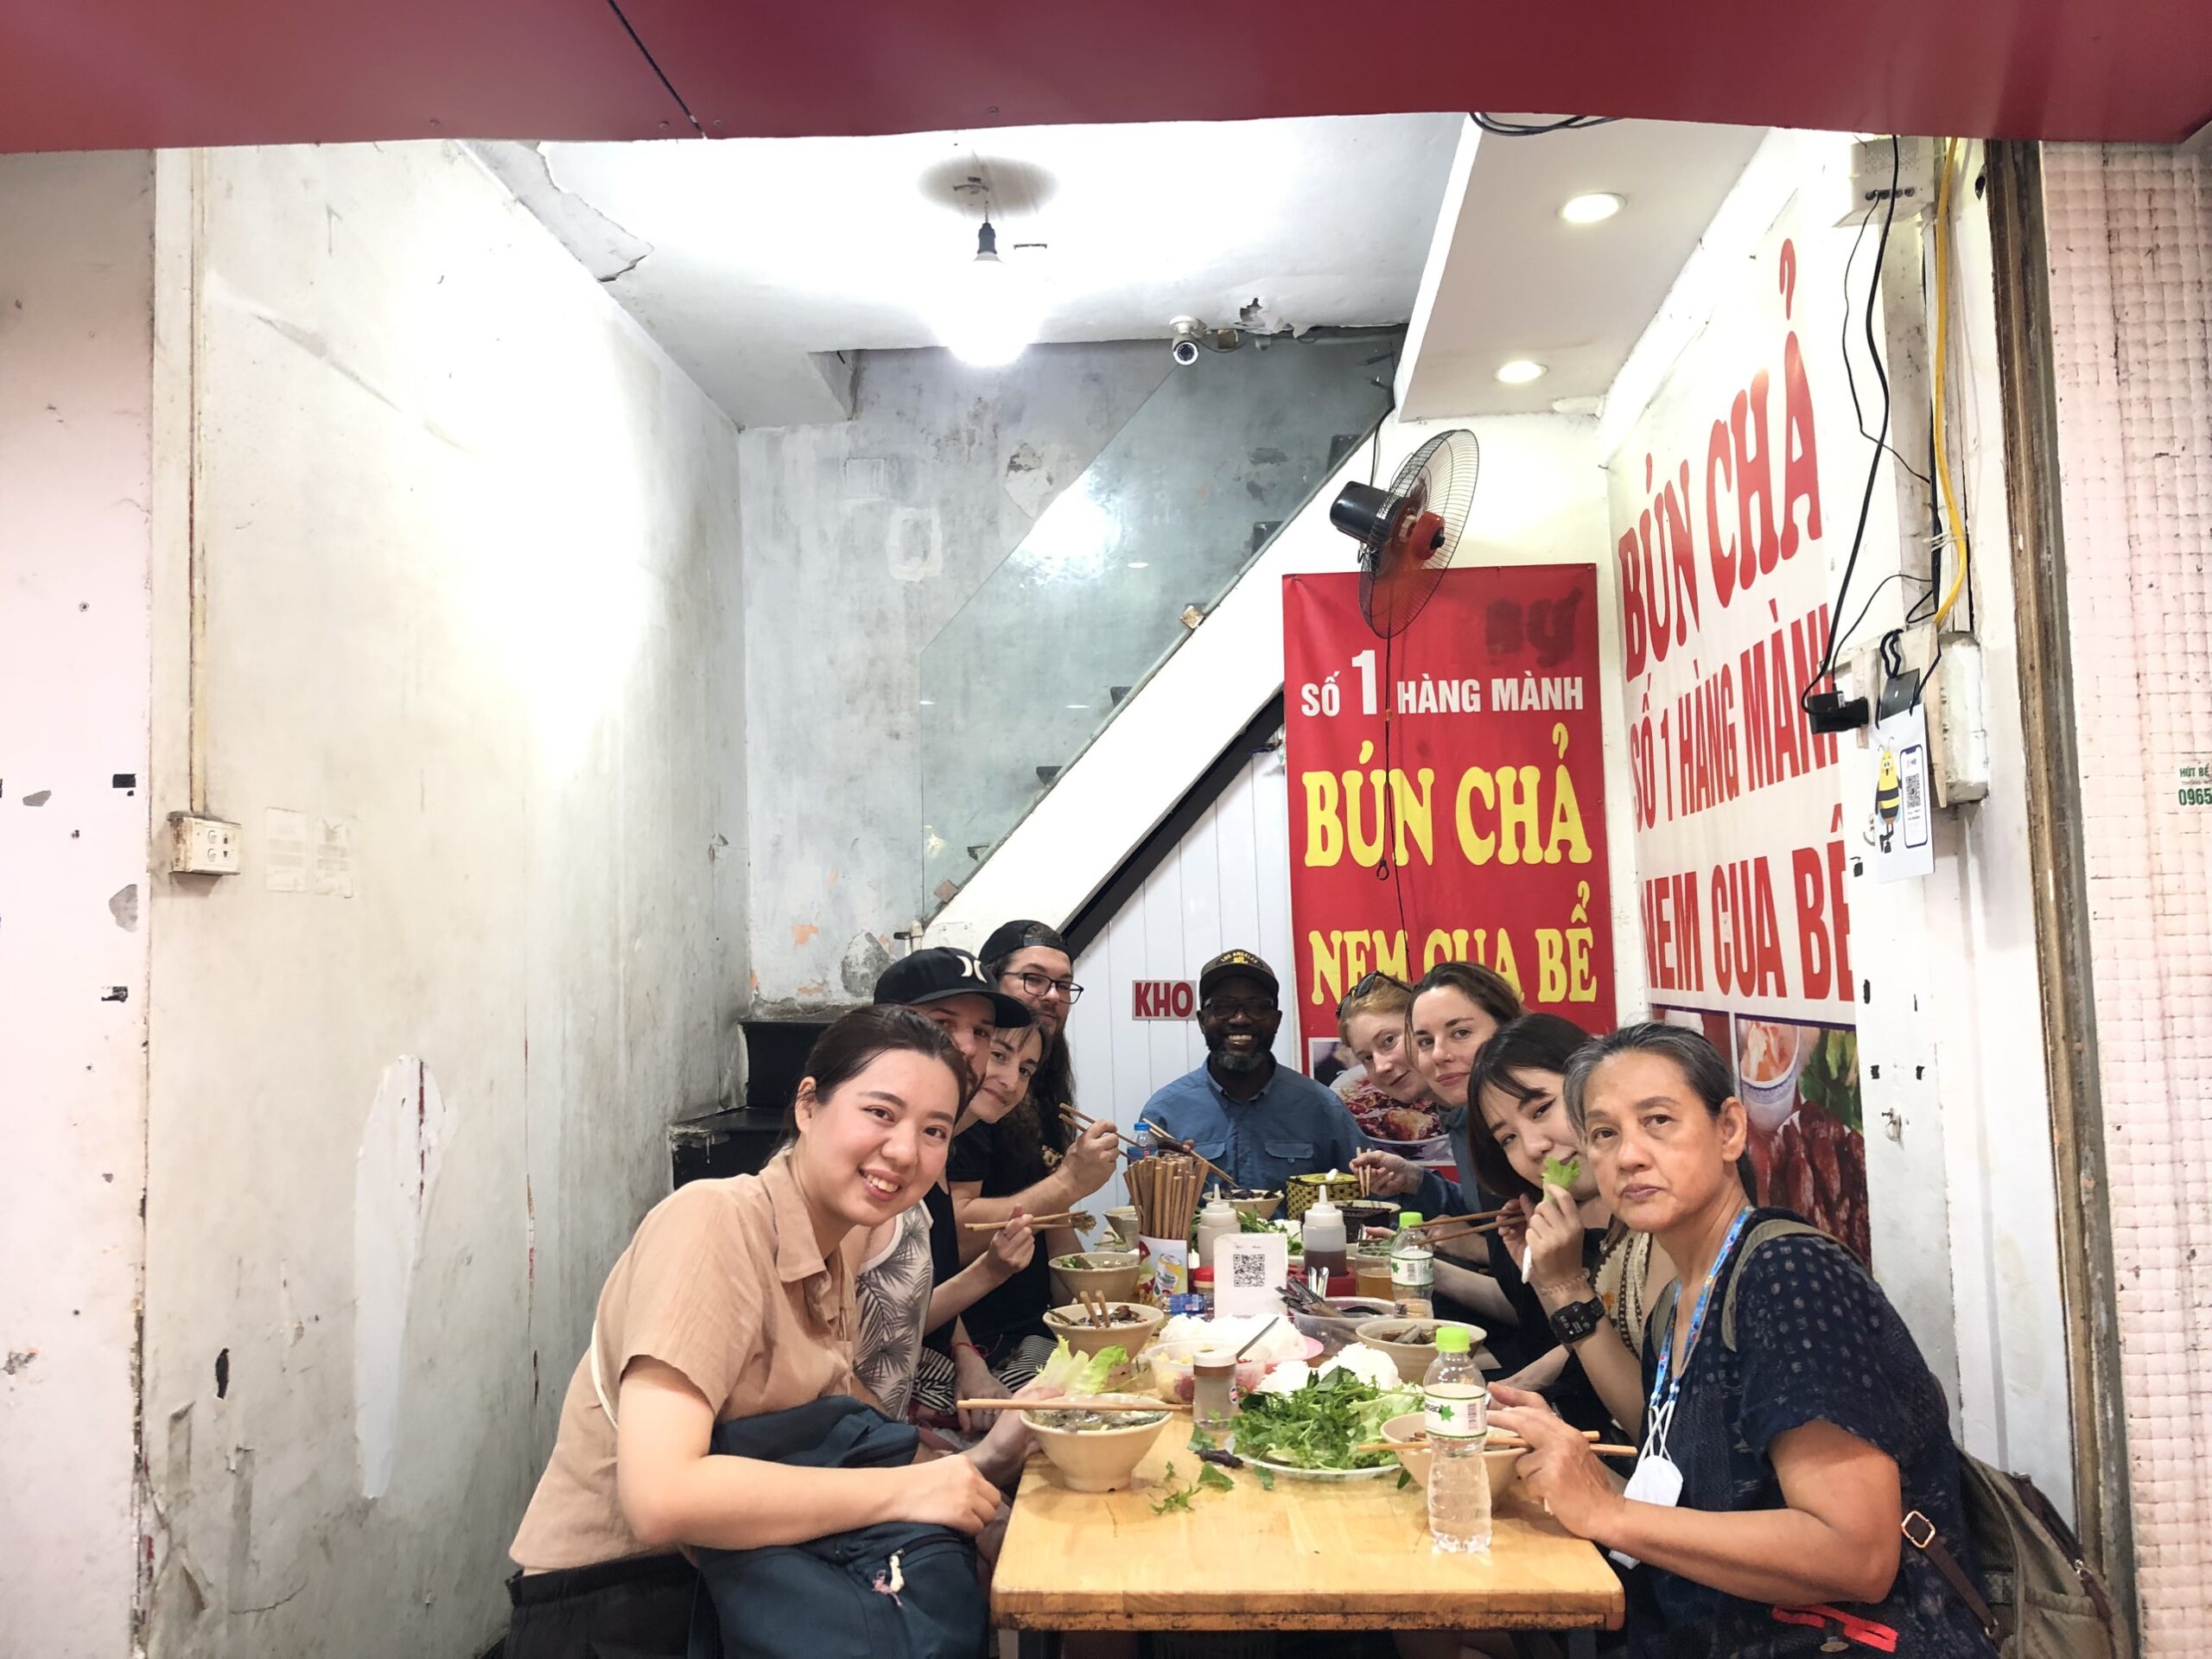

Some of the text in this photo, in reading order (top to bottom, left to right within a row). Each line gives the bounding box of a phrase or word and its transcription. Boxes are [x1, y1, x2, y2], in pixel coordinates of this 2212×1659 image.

[1618, 238, 1822, 683] BÚN CHẢ
[1300, 650, 1584, 716] SỐ 1 HÀNG MÀNH
[1630, 671, 1656, 833] SỐ
[1661, 709, 1674, 822] 1
[1678, 659, 1740, 817] HÀNG
[1301, 722, 1592, 868] BÚN CHẢ
[1535, 880, 1597, 1003] BỂ
[1641, 871, 1704, 992] NEM
[1711, 856, 1787, 998] CUA
[1135, 982, 1193, 1018] KHO
